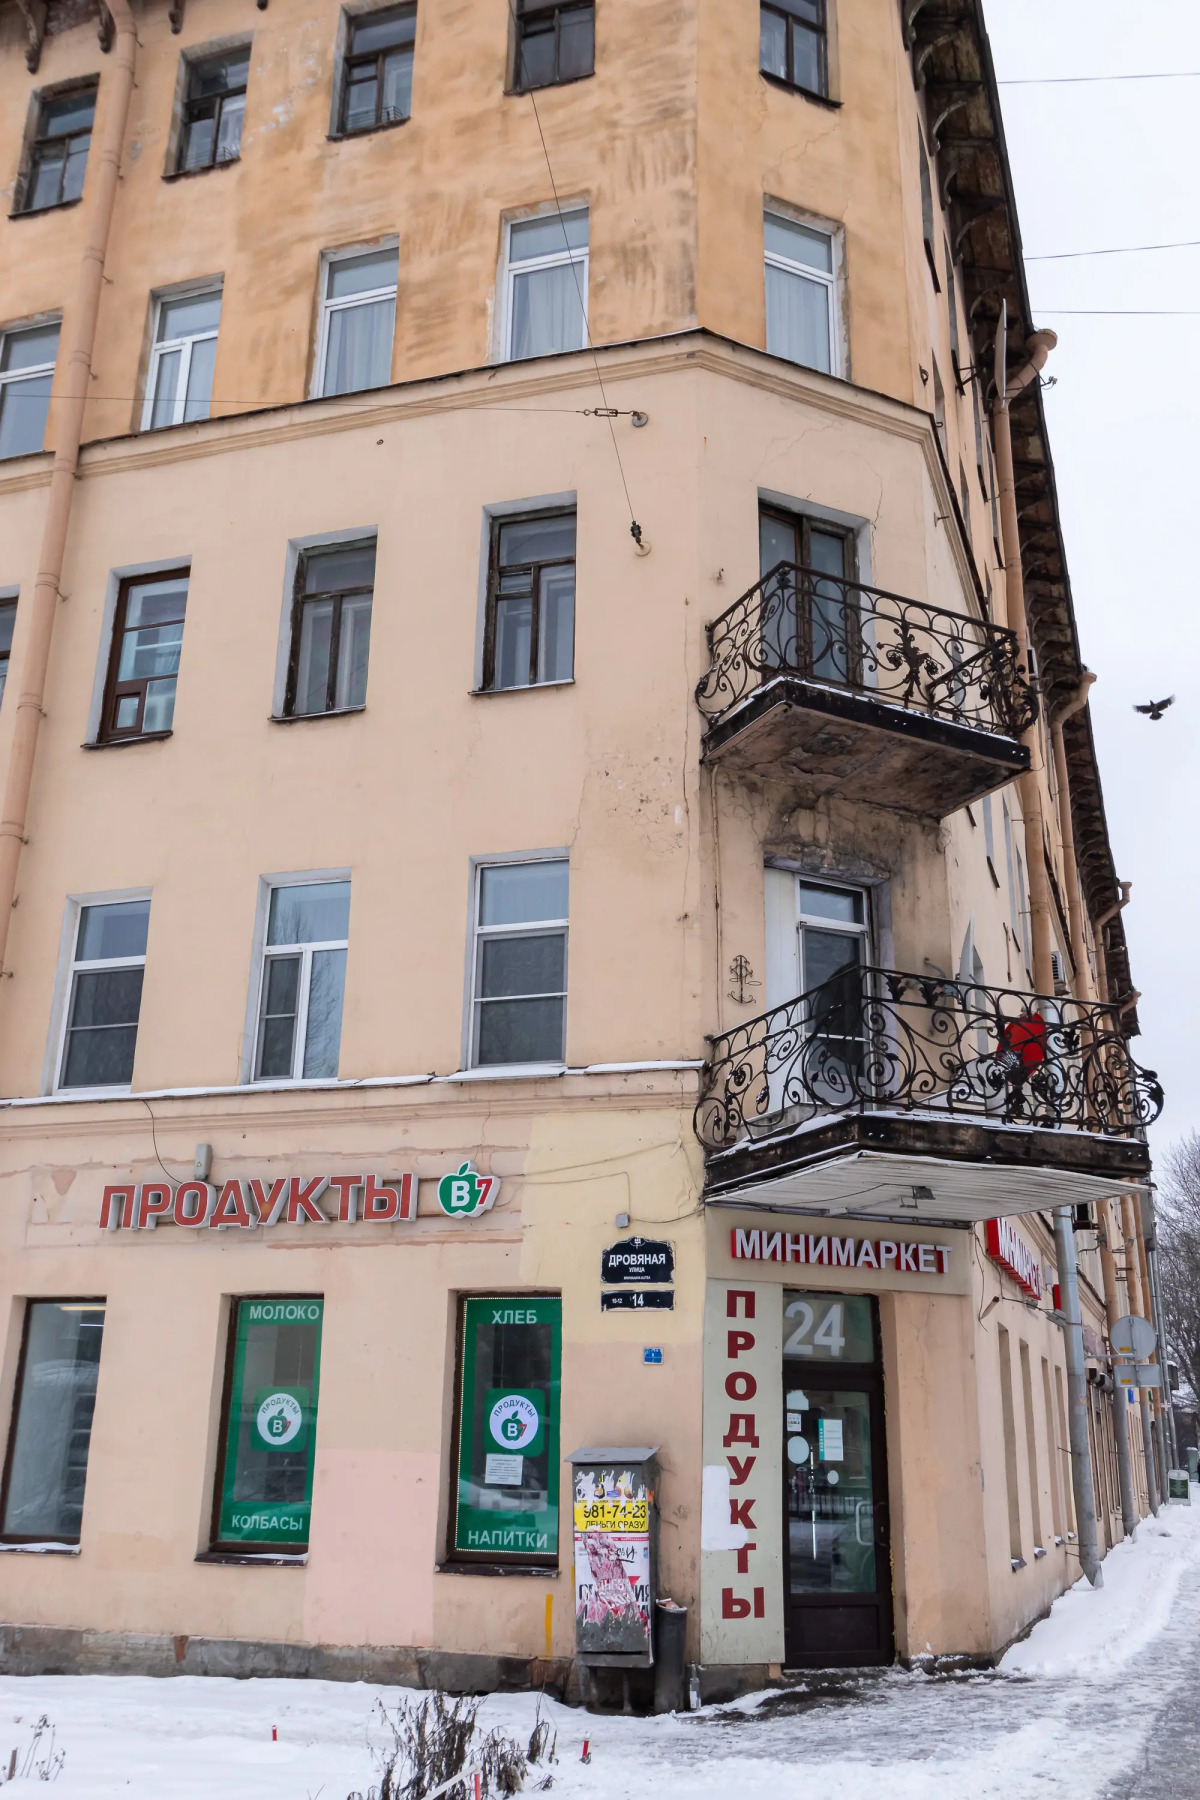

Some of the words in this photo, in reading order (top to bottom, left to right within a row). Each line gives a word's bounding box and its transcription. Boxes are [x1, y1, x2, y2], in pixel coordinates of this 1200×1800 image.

[98, 1173, 415, 1230] ПРОДУКТЫ
[733, 1227, 953, 1274] МИНИМАРКЕТ
[608, 1253, 666, 1267] ДРОВЯНАЯ
[632, 1293, 644, 1306] 14
[249, 1305, 320, 1320] МОЛОКО
[491, 1309, 538, 1325] ХЛЕБ
[783, 1301, 846, 1357] 24
[261, 1397, 300, 1415] ПРОДУКТЫ
[493, 1399, 536, 1417] ПРОДУКТЫ
[721, 1289, 765, 1620] ПРОДУКТЫ
[231, 1514, 303, 1531] КОЛБАСЫ
[467, 1529, 548, 1549] НАПИТКИ
